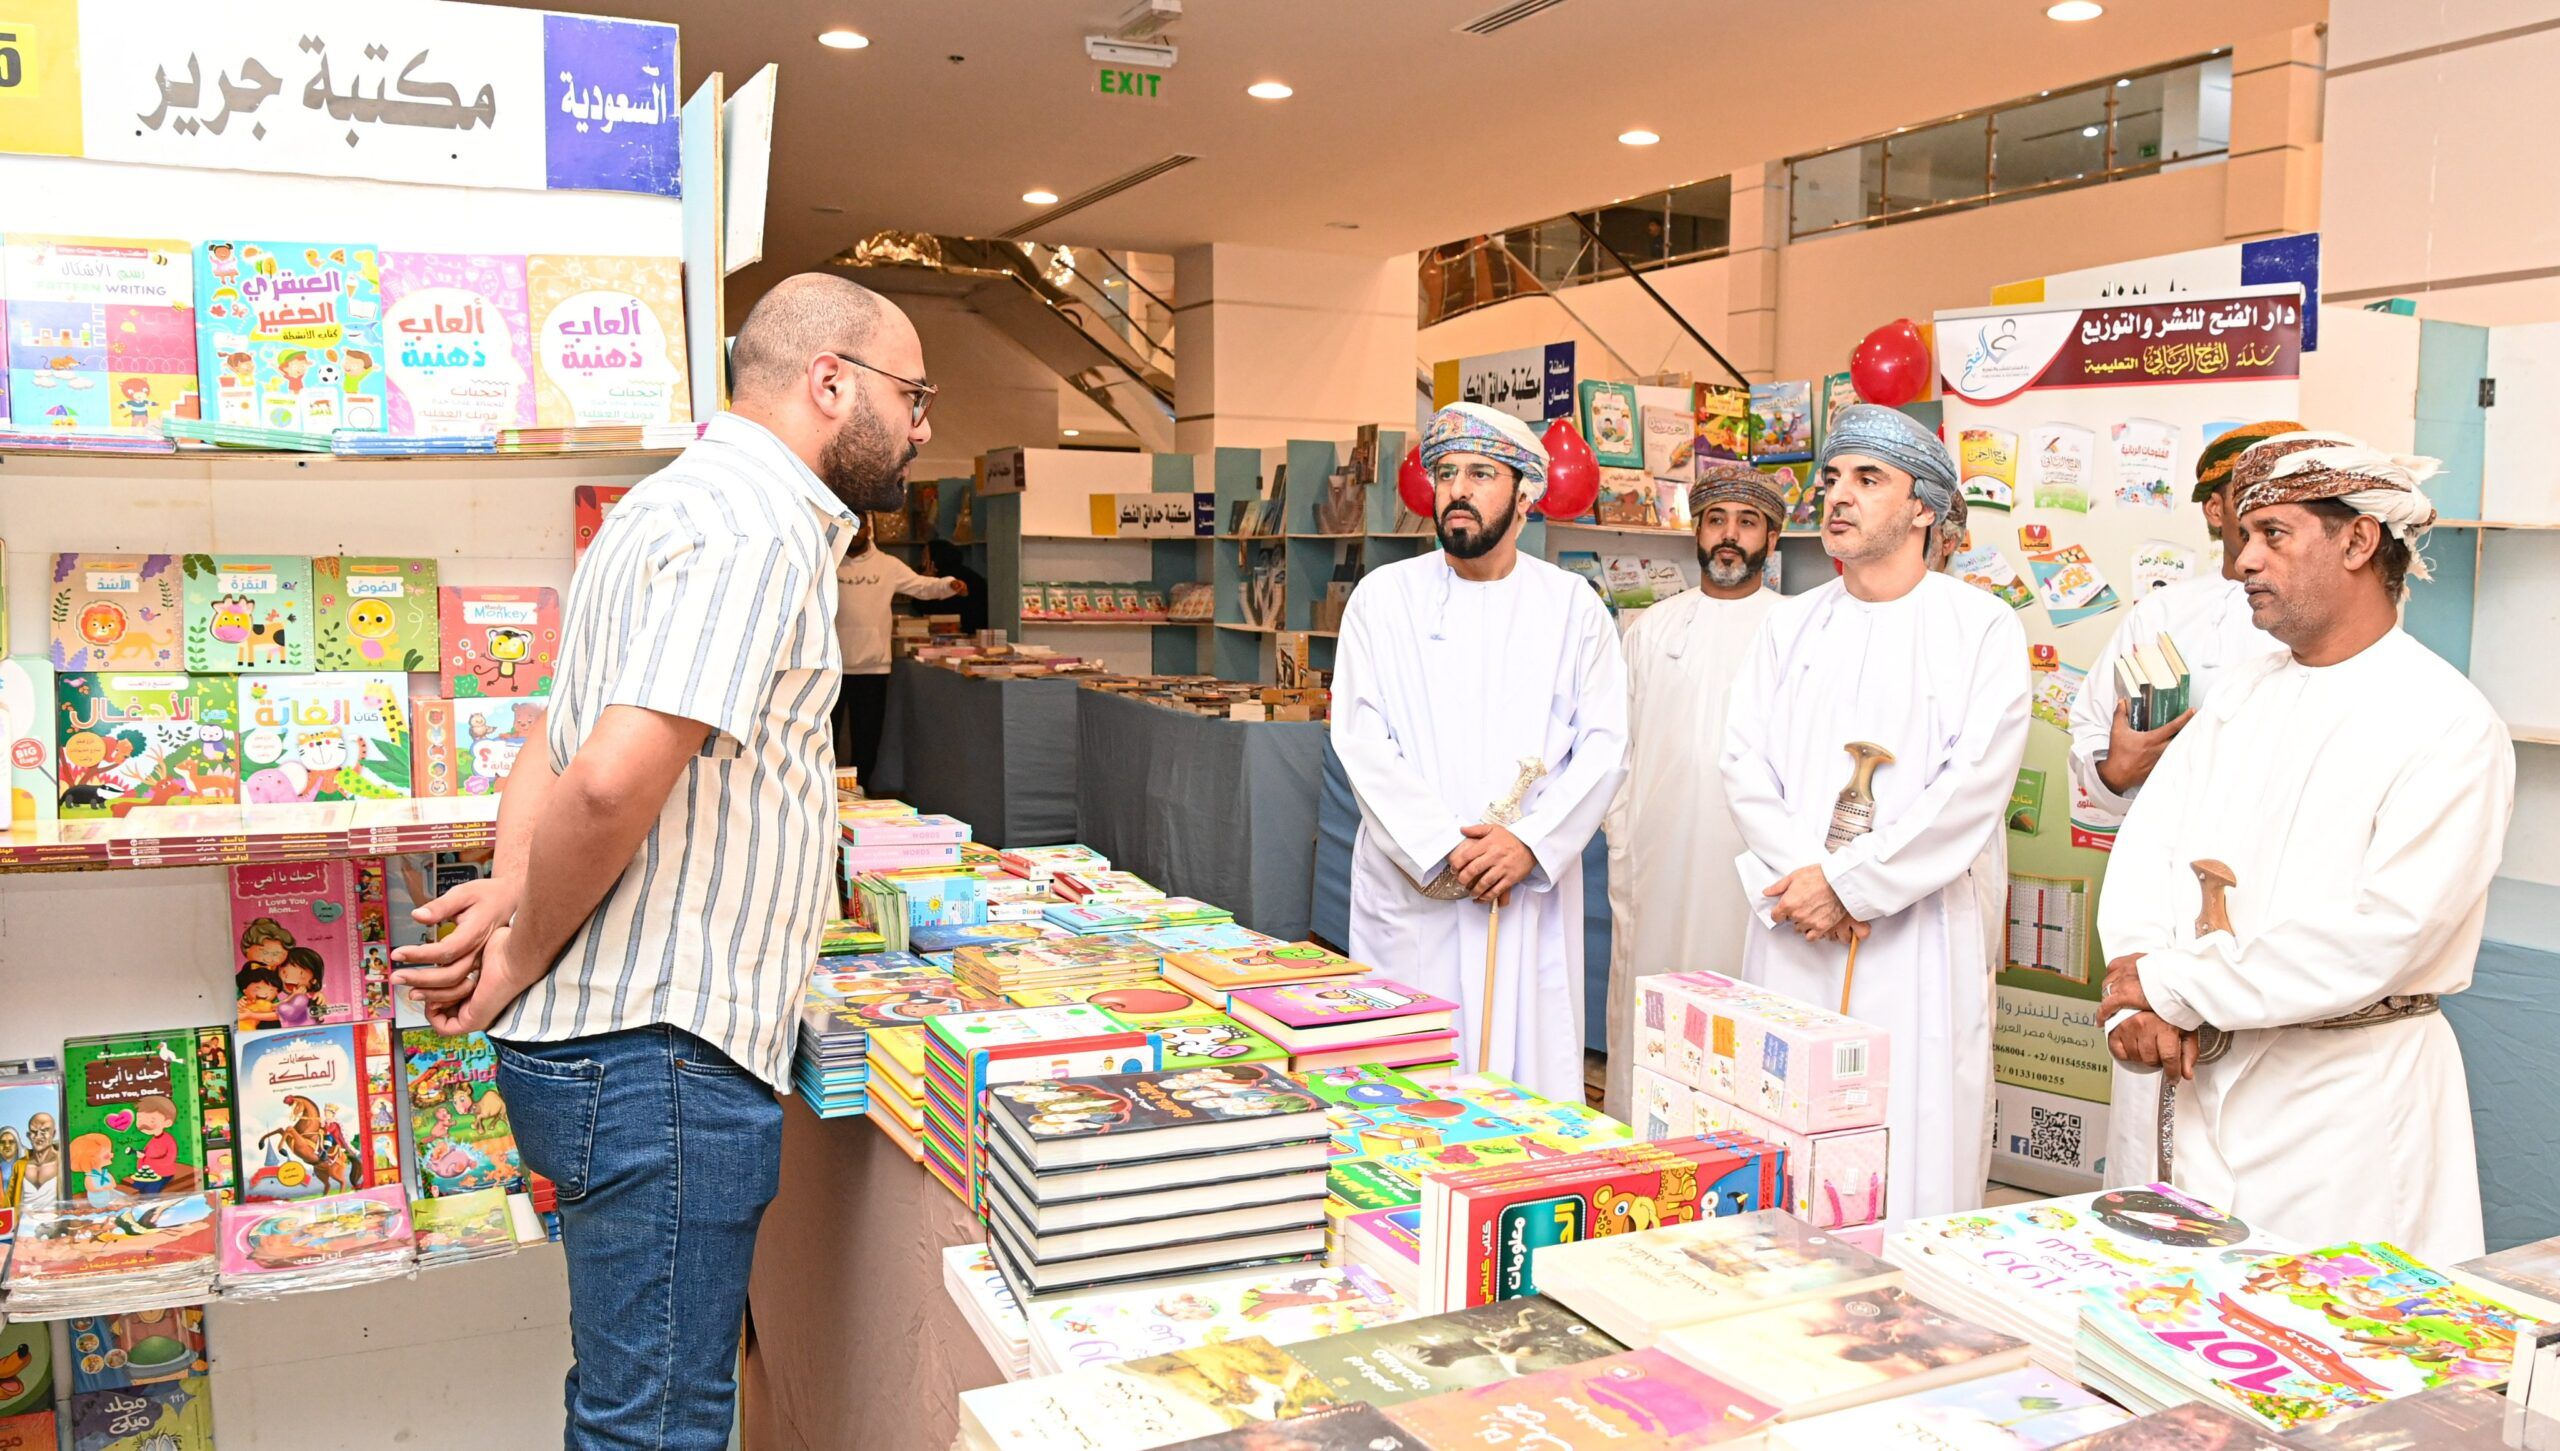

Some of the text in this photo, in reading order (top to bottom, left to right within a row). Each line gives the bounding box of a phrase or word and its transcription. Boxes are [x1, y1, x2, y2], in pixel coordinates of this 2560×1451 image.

[138, 34, 497, 149] مكتبة جرير
[1100, 69, 1162, 98] EXIT
[558, 62, 669, 135] السعودية
[105, 284, 167, 296] WRITING
[242, 270, 341, 302] العبقري
[258, 301, 335, 333] الصغير
[398, 298, 485, 342] ألعاب
[558, 299, 642, 344] ألعاب
[2154, 308, 2204, 339] للنشر
[2208, 304, 2258, 338] الفتح
[2262, 303, 2297, 333] دار
[400, 340, 487, 376] ذهنية
[561, 341, 643, 377] ذهنية
[2083, 356, 2139, 376] التعليمية
[1463, 372, 1486, 405] الفك
[1511, 366, 1542, 411] مكتبة
[1165, 502, 1192, 529] مكتبة
[473, 606, 528, 624] Monkey
[68, 692, 200, 730] الأدغال
[353, 711, 380, 724] كتاب
[15, 746, 37, 759] BIG
[902, 848, 930, 856] WORDS
[278, 871, 287, 886] يا
[289, 866, 320, 885] أحبك
[265, 899, 287, 907] Love
[289, 897, 309, 906] You,
[2014, 1001, 2059, 1020] للنشر
[2062, 1011, 2096, 1027] لفتح
[2023, 1028, 2045, 1039] مصر
[2046, 1030, 2088, 1048] جمهورية
[124, 1069, 134, 1085] يا
[135, 1062, 169, 1083] أحبك
[268, 1059, 336, 1086] المملكة
[2008, 1067, 2065, 1085] 0133100255
[101, 1092, 120, 1100] Love
[121, 1090, 140, 1098] You,
[1481, 1220, 1493, 1256] كتاب
[1507, 1216, 1528, 1290] معلومات
[2156, 1328, 2297, 1396] 101
[104, 1395, 147, 1414] مجلد
[169, 1393, 186, 1404] 111
